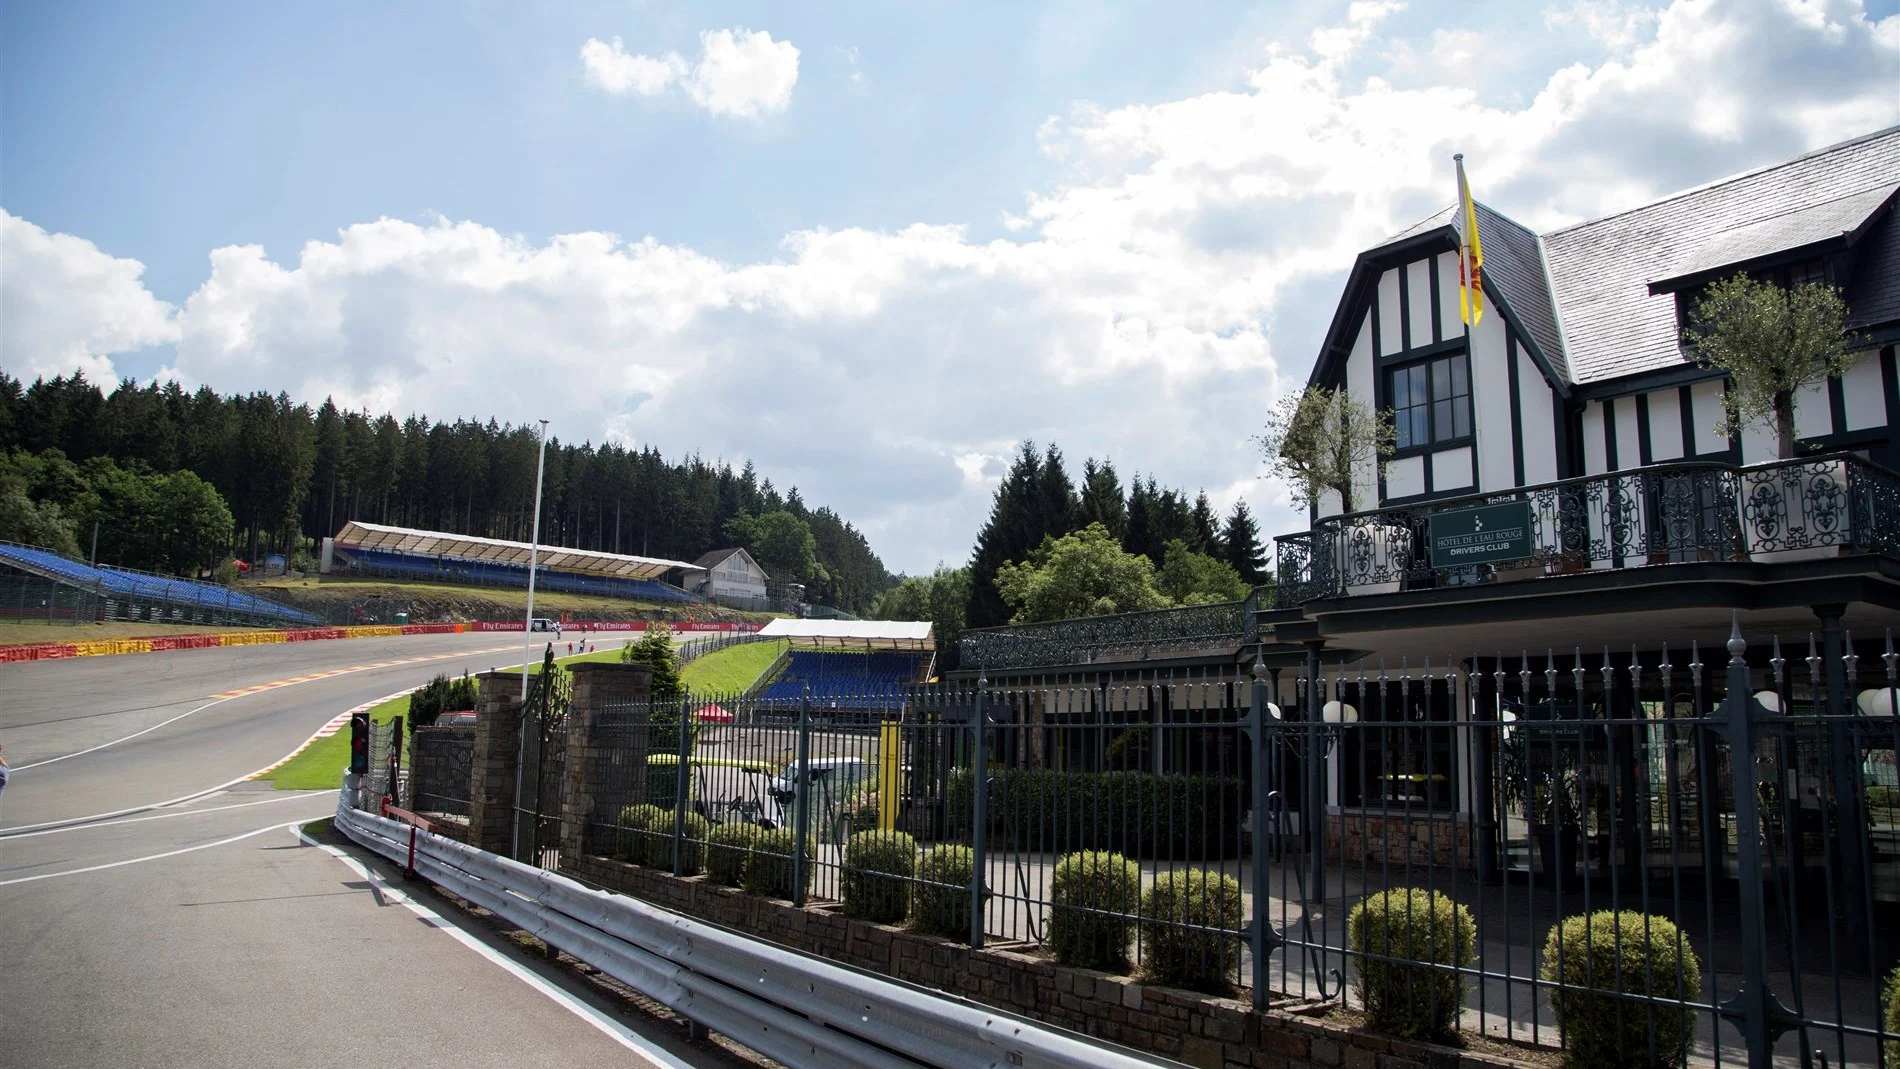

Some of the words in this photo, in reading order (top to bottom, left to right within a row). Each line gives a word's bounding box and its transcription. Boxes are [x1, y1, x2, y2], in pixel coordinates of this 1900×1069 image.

[1437, 537, 1461, 548] HÔTEL
[1463, 536, 1473, 544] DE
[1474, 532, 1494, 543] L'EAU
[1496, 529, 1523, 540] ROUGE
[1450, 545, 1485, 556] DRIVERS
[1486, 542, 1510, 551] CLUB
[482, 622, 494, 630] Fly
[495, 622, 524, 630] Emirates
[596, 622, 605, 630] Fly
[606, 622, 631, 630] Emirates
